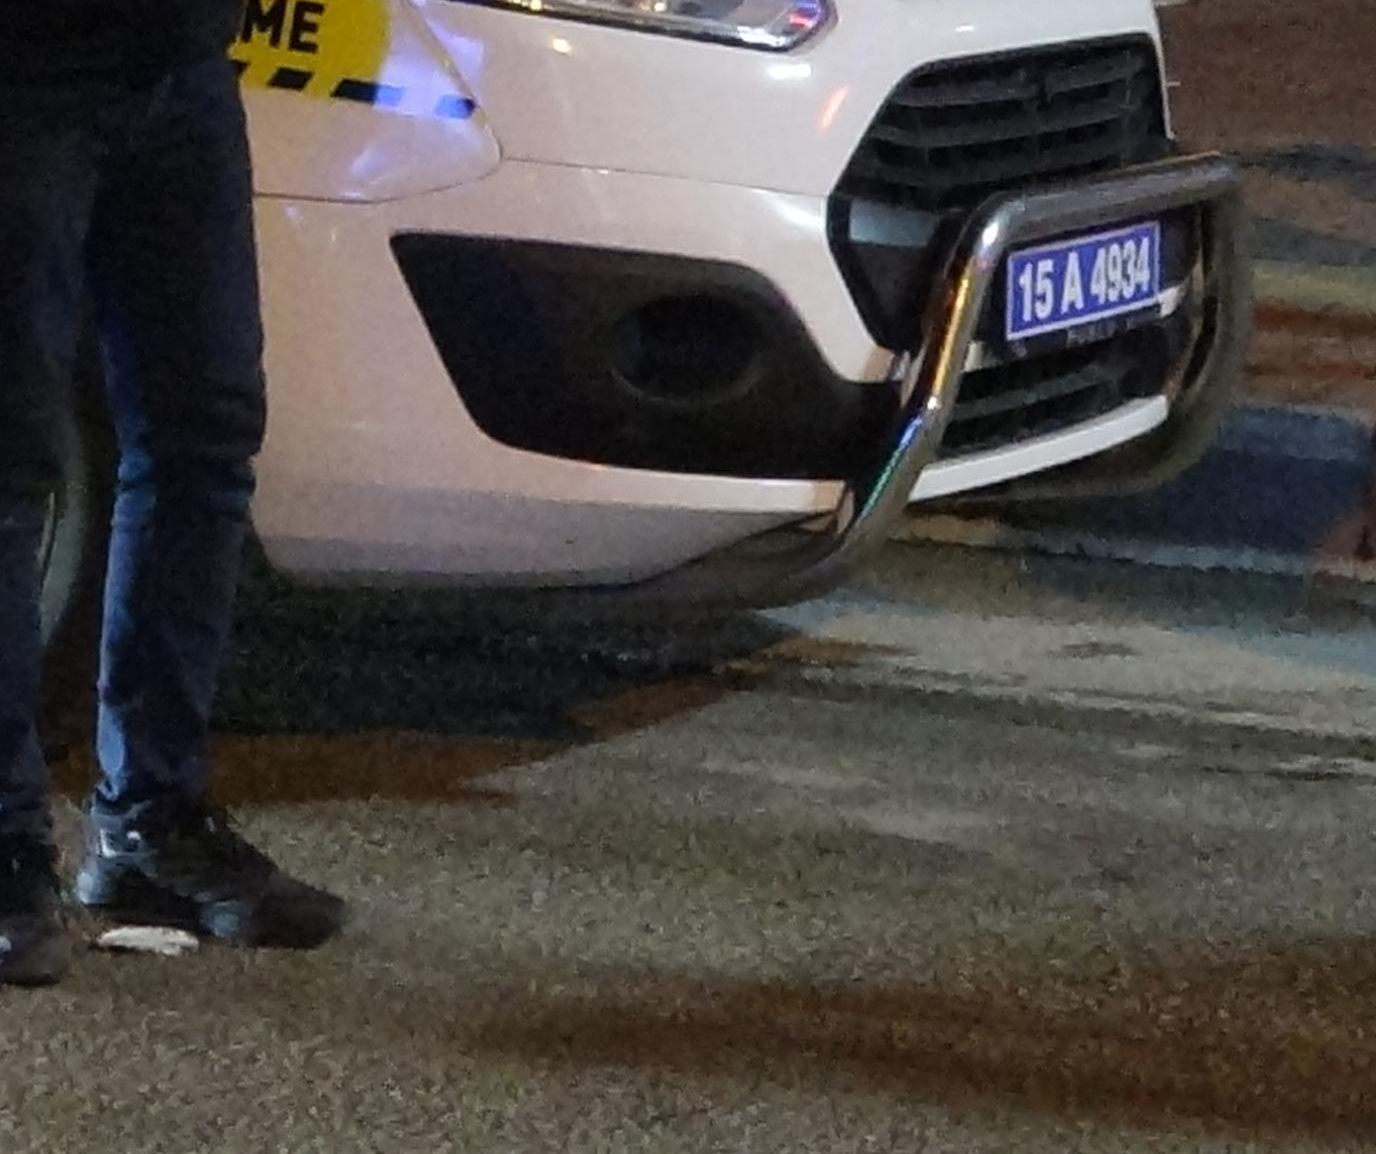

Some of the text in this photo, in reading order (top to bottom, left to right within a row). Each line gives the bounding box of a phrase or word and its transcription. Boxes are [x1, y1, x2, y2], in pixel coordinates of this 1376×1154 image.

[1018, 236, 1152, 323] 15 A 4934
